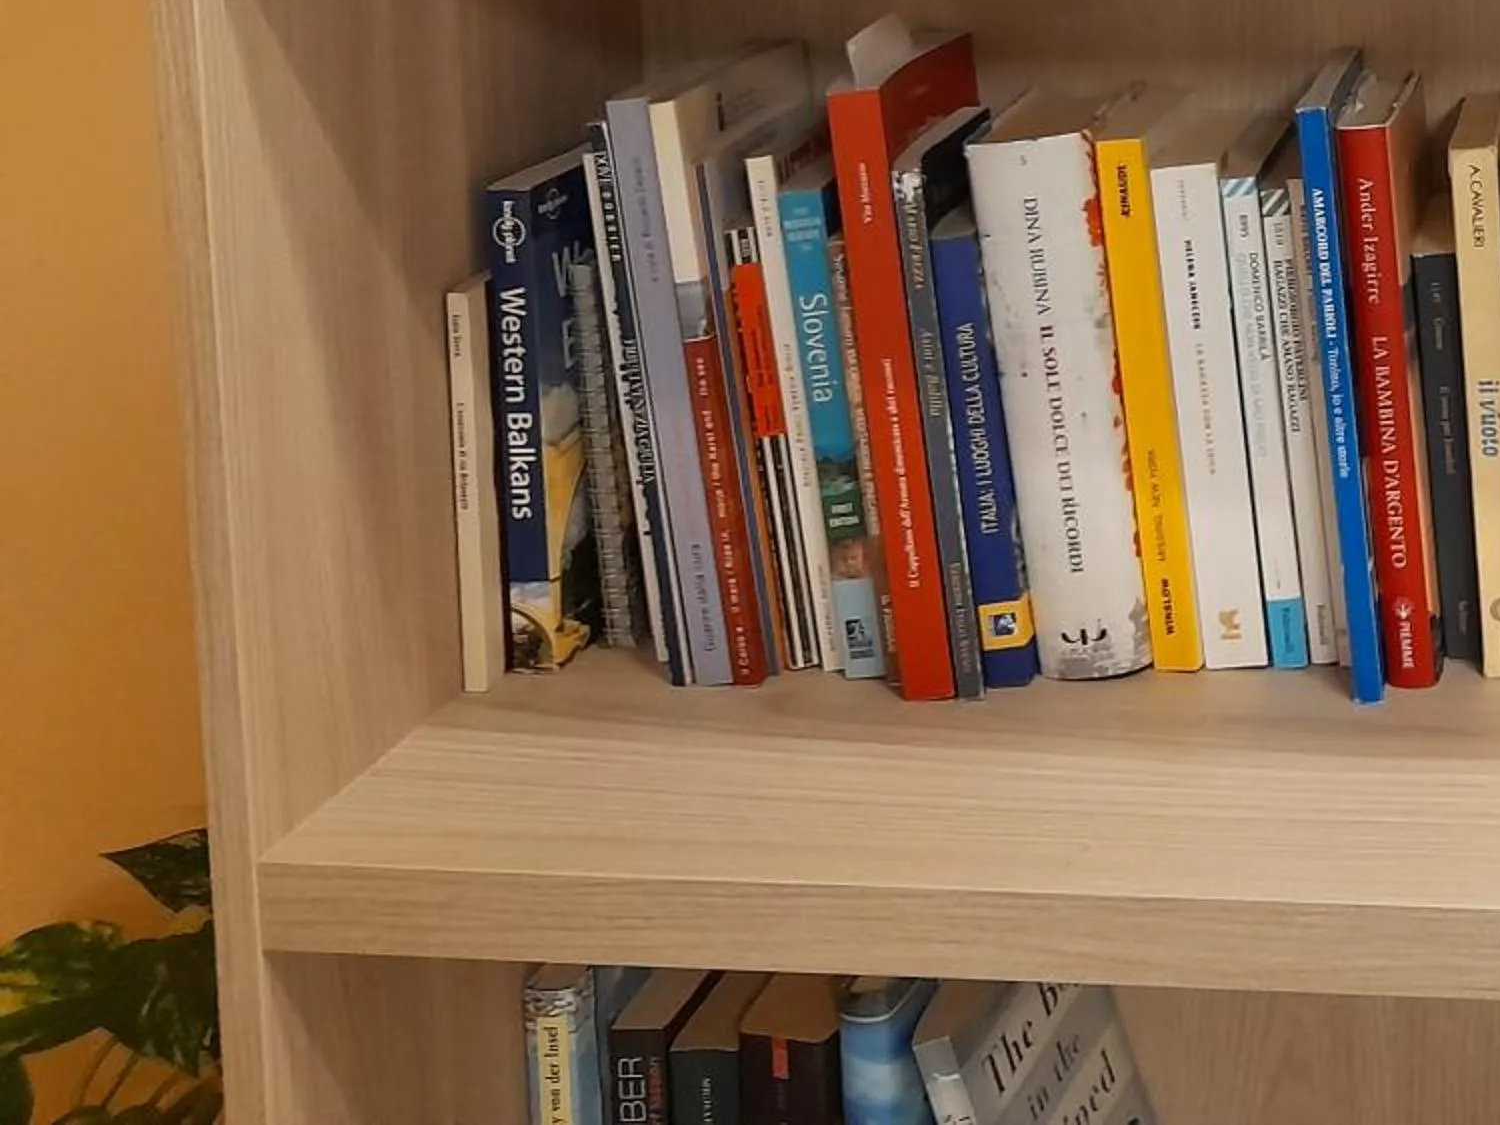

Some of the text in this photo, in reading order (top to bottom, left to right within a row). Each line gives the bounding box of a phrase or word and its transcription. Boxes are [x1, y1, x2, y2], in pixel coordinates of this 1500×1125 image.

[1116, 165, 1131, 218] EINAUDI
[1357, 178, 1380, 305] Ander Izagirre
[800, 293, 838, 403] Slovenia
[957, 323, 980, 381] CULTURA
[500, 287, 538, 520] Western Balkans
[964, 384, 986, 424] DELLA
[1023, 197, 1084, 573] DINA RUBINA IL SOLE DOLCE DEI RICORDI
[1478, 379, 1500, 392] il
[969, 427, 993, 477] LUOGHI
[1371, 336, 1407, 568] LA BAMBINA D'ARGENTO
[976, 488, 999, 533] ITALIA:
[1161, 578, 1175, 635] WINSLOW
[1400, 622, 1414, 668] PIEMME
[545, 1025, 561, 1113] von der Insel
[981, 1020, 1033, 1098] The
[1026, 1085, 1050, 1121] in
[1053, 1034, 1081, 1083] the
